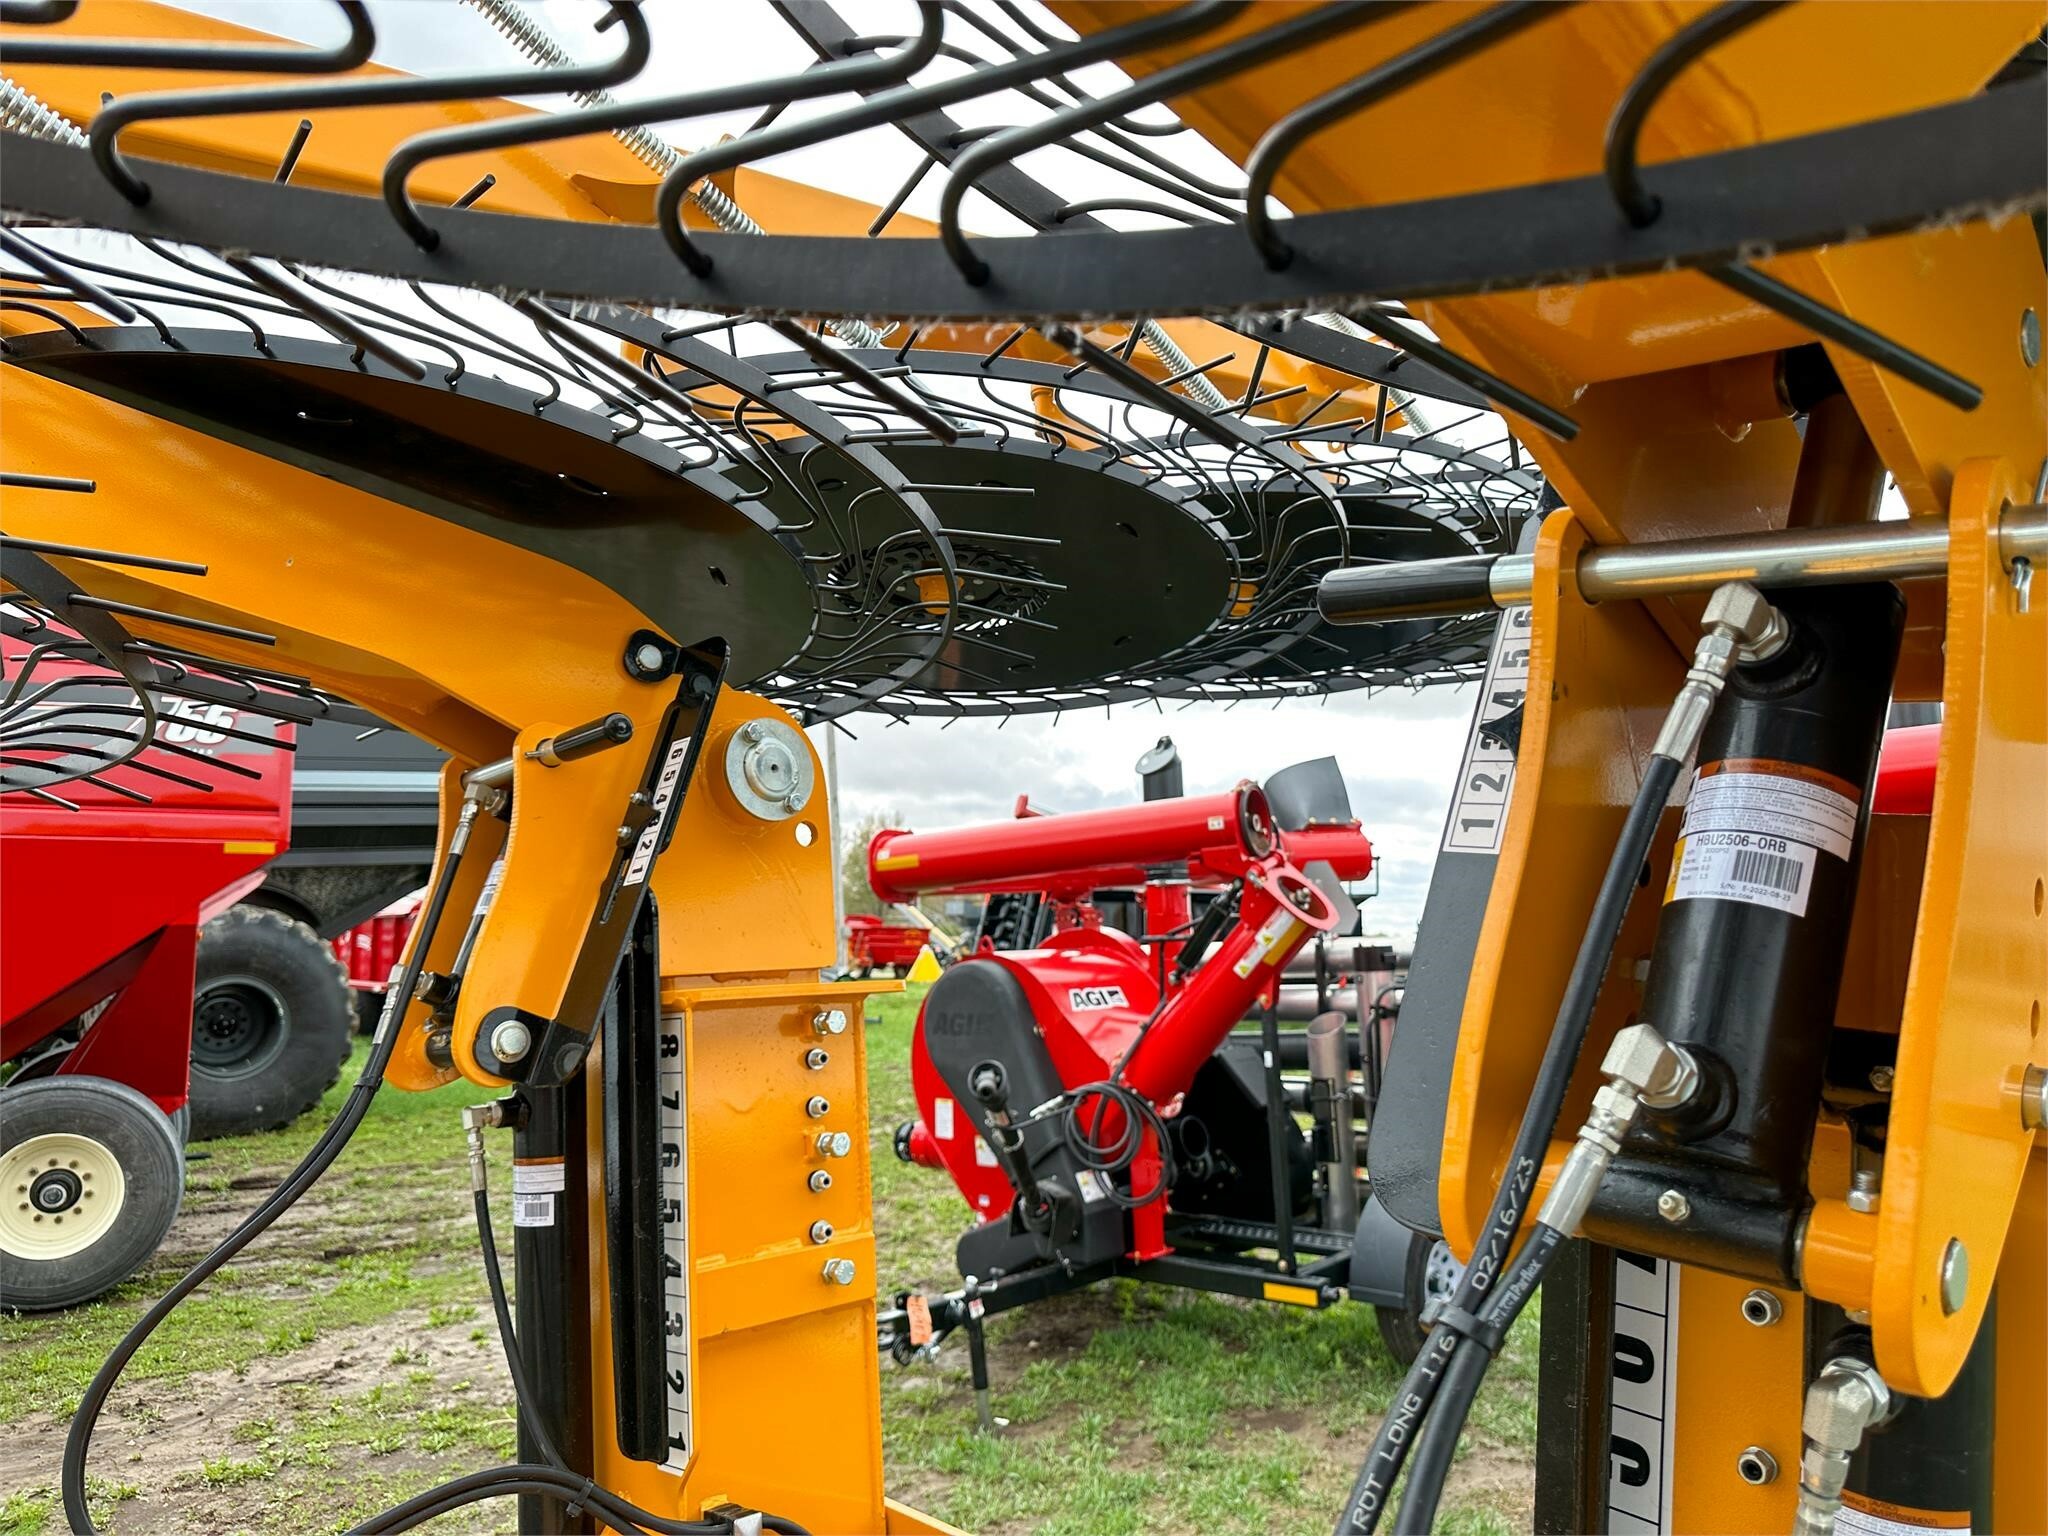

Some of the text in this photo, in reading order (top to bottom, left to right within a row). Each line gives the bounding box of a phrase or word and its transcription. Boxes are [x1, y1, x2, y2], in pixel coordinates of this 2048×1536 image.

[1500, 649, 1530, 668] 5
[1492, 689, 1527, 708] 4
[671, 748, 683, 760] 6
[663, 769, 676, 782] 5
[1470, 773, 1506, 792] 2
[1461, 819, 1495, 832] 1
[640, 839, 652, 851] 2
[1696, 833, 1788, 853] HBU2506-ORB
[632, 864, 643, 874] 1
[1072, 990, 1108, 1008] AGI
[661, 1034, 686, 1451] 8 7 6 5 4 3 2 1
[1511, 1258, 1542, 1297] Parflex
[1379, 1392, 1422, 1462] LONG
[1421, 1335, 1456, 1382] 116
[1471, 1156, 1536, 1291] 02/16/23
